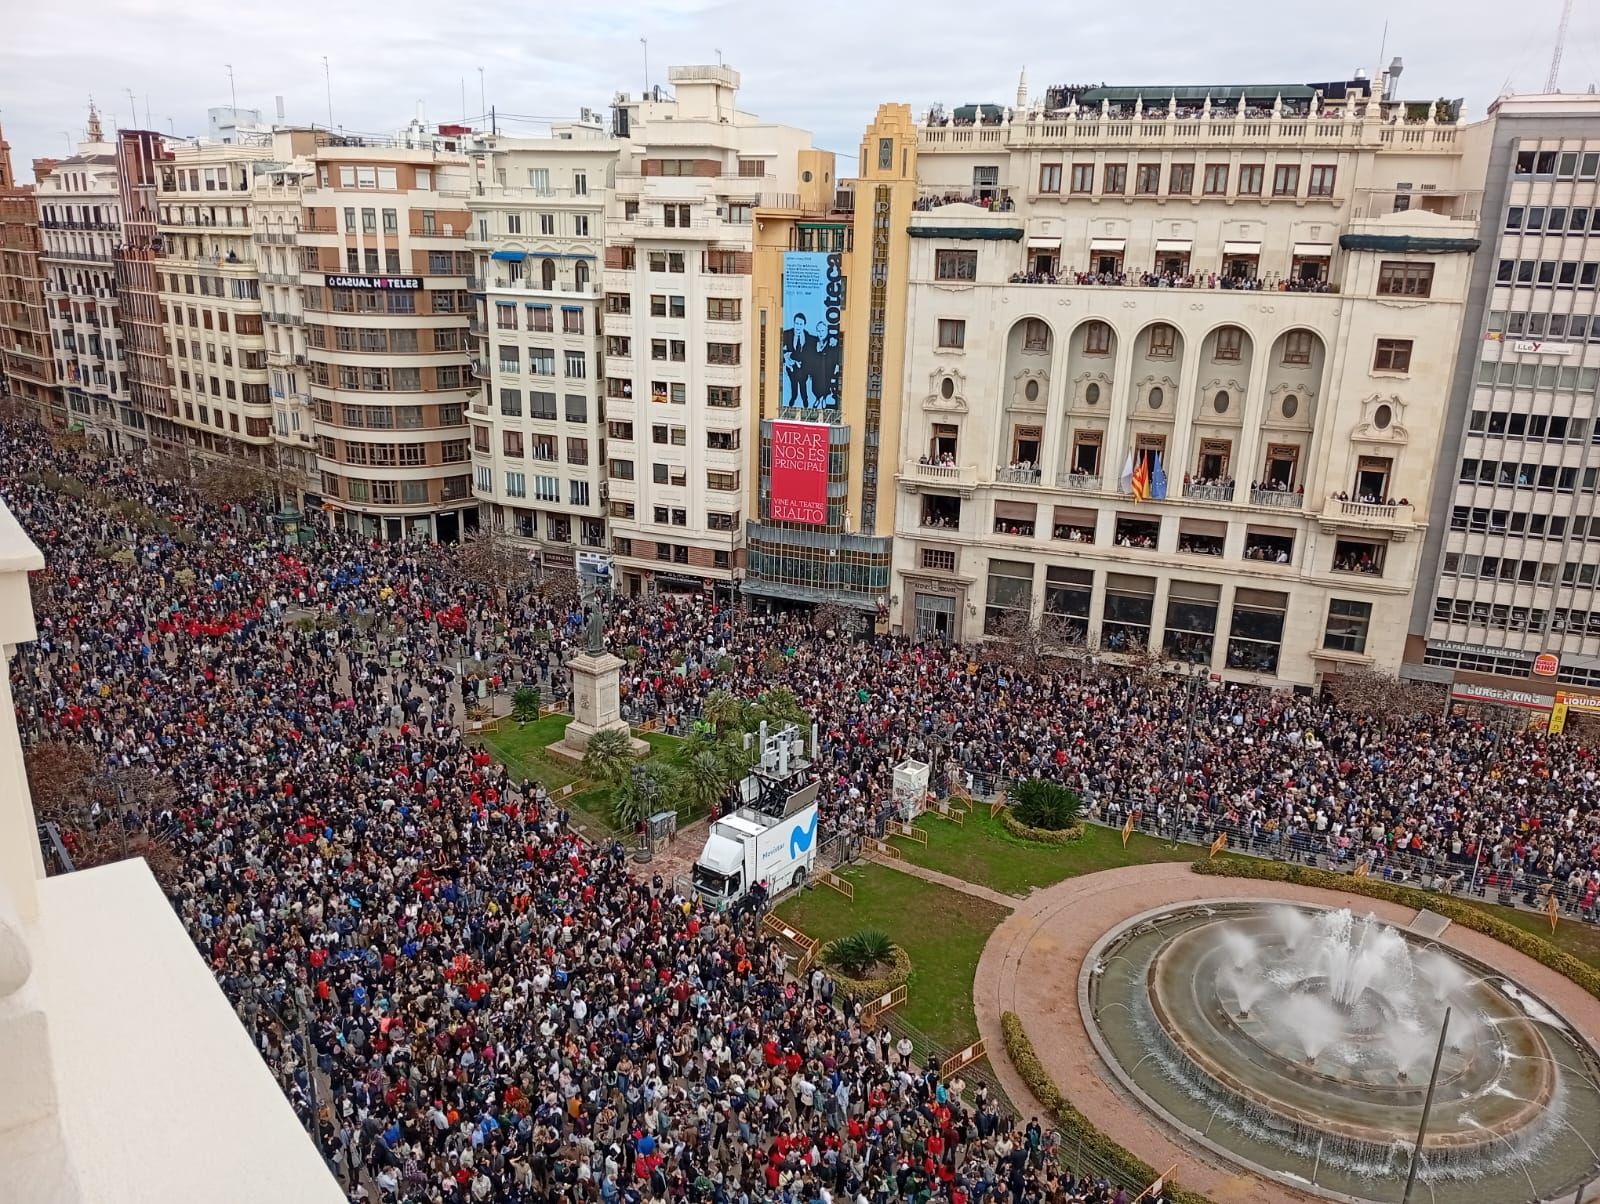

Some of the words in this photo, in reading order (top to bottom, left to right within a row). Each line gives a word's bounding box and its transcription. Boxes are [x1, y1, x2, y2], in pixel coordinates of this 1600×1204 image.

[337, 277, 372, 288] CASUAL
[775, 430, 826, 447] MIRAR-
[775, 445, 805, 460] NOS
[808, 448, 825, 462] ES
[775, 458, 825, 473] PRINCIPAL
[774, 498, 789, 506] VINE
[790, 499, 798, 507] AL
[799, 500, 824, 510] TEATRE
[774, 505, 824, 522] RIALTO
[1536, 664, 1556, 672] KING
[1467, 686, 1511, 699] BURGER
[1512, 691, 1541, 704] KING
